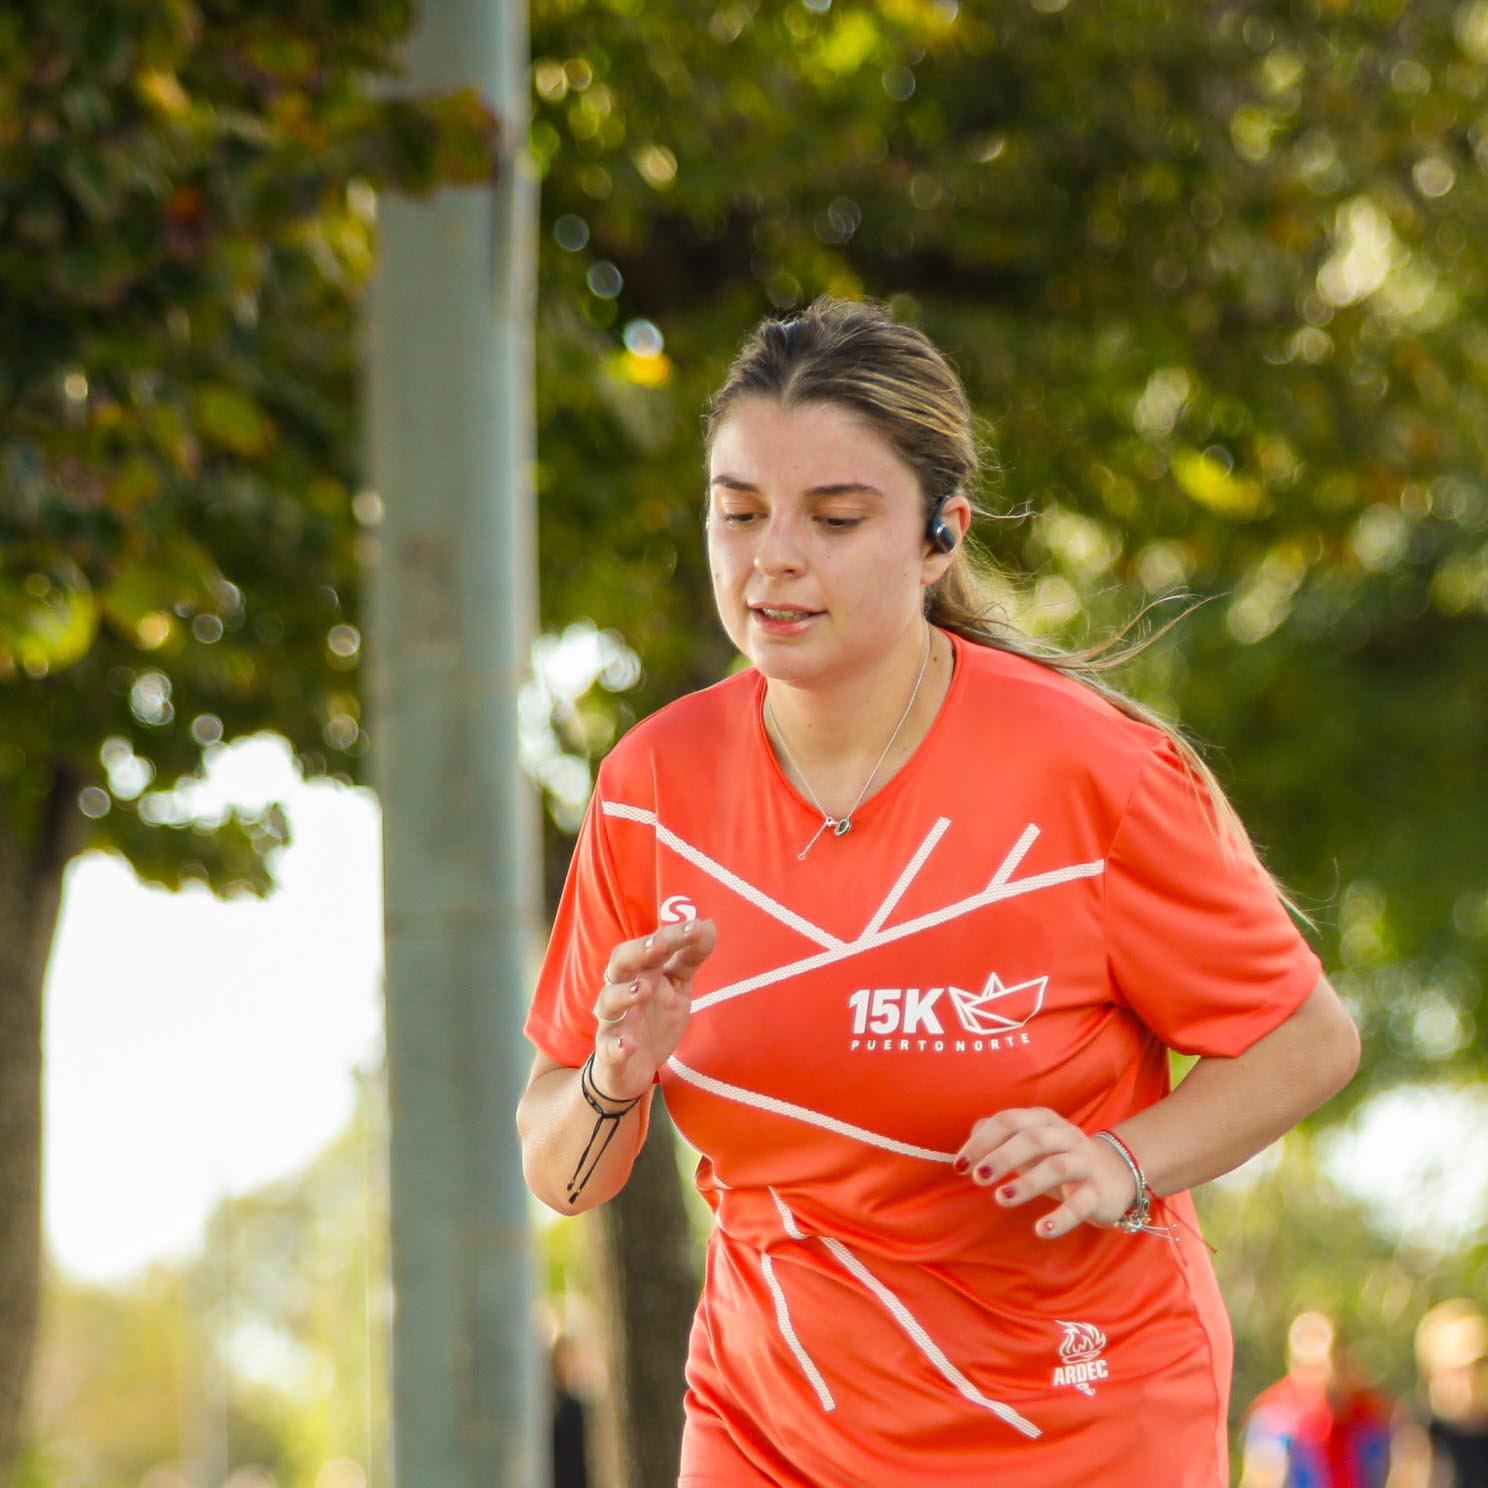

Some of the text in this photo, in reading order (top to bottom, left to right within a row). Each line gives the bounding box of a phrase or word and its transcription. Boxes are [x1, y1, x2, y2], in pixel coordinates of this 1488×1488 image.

[849, 988, 945, 1034] 15K
[851, 1032, 1031, 1052] PUERTO NORTE
[1053, 1359, 1109, 1387] ARDEC
